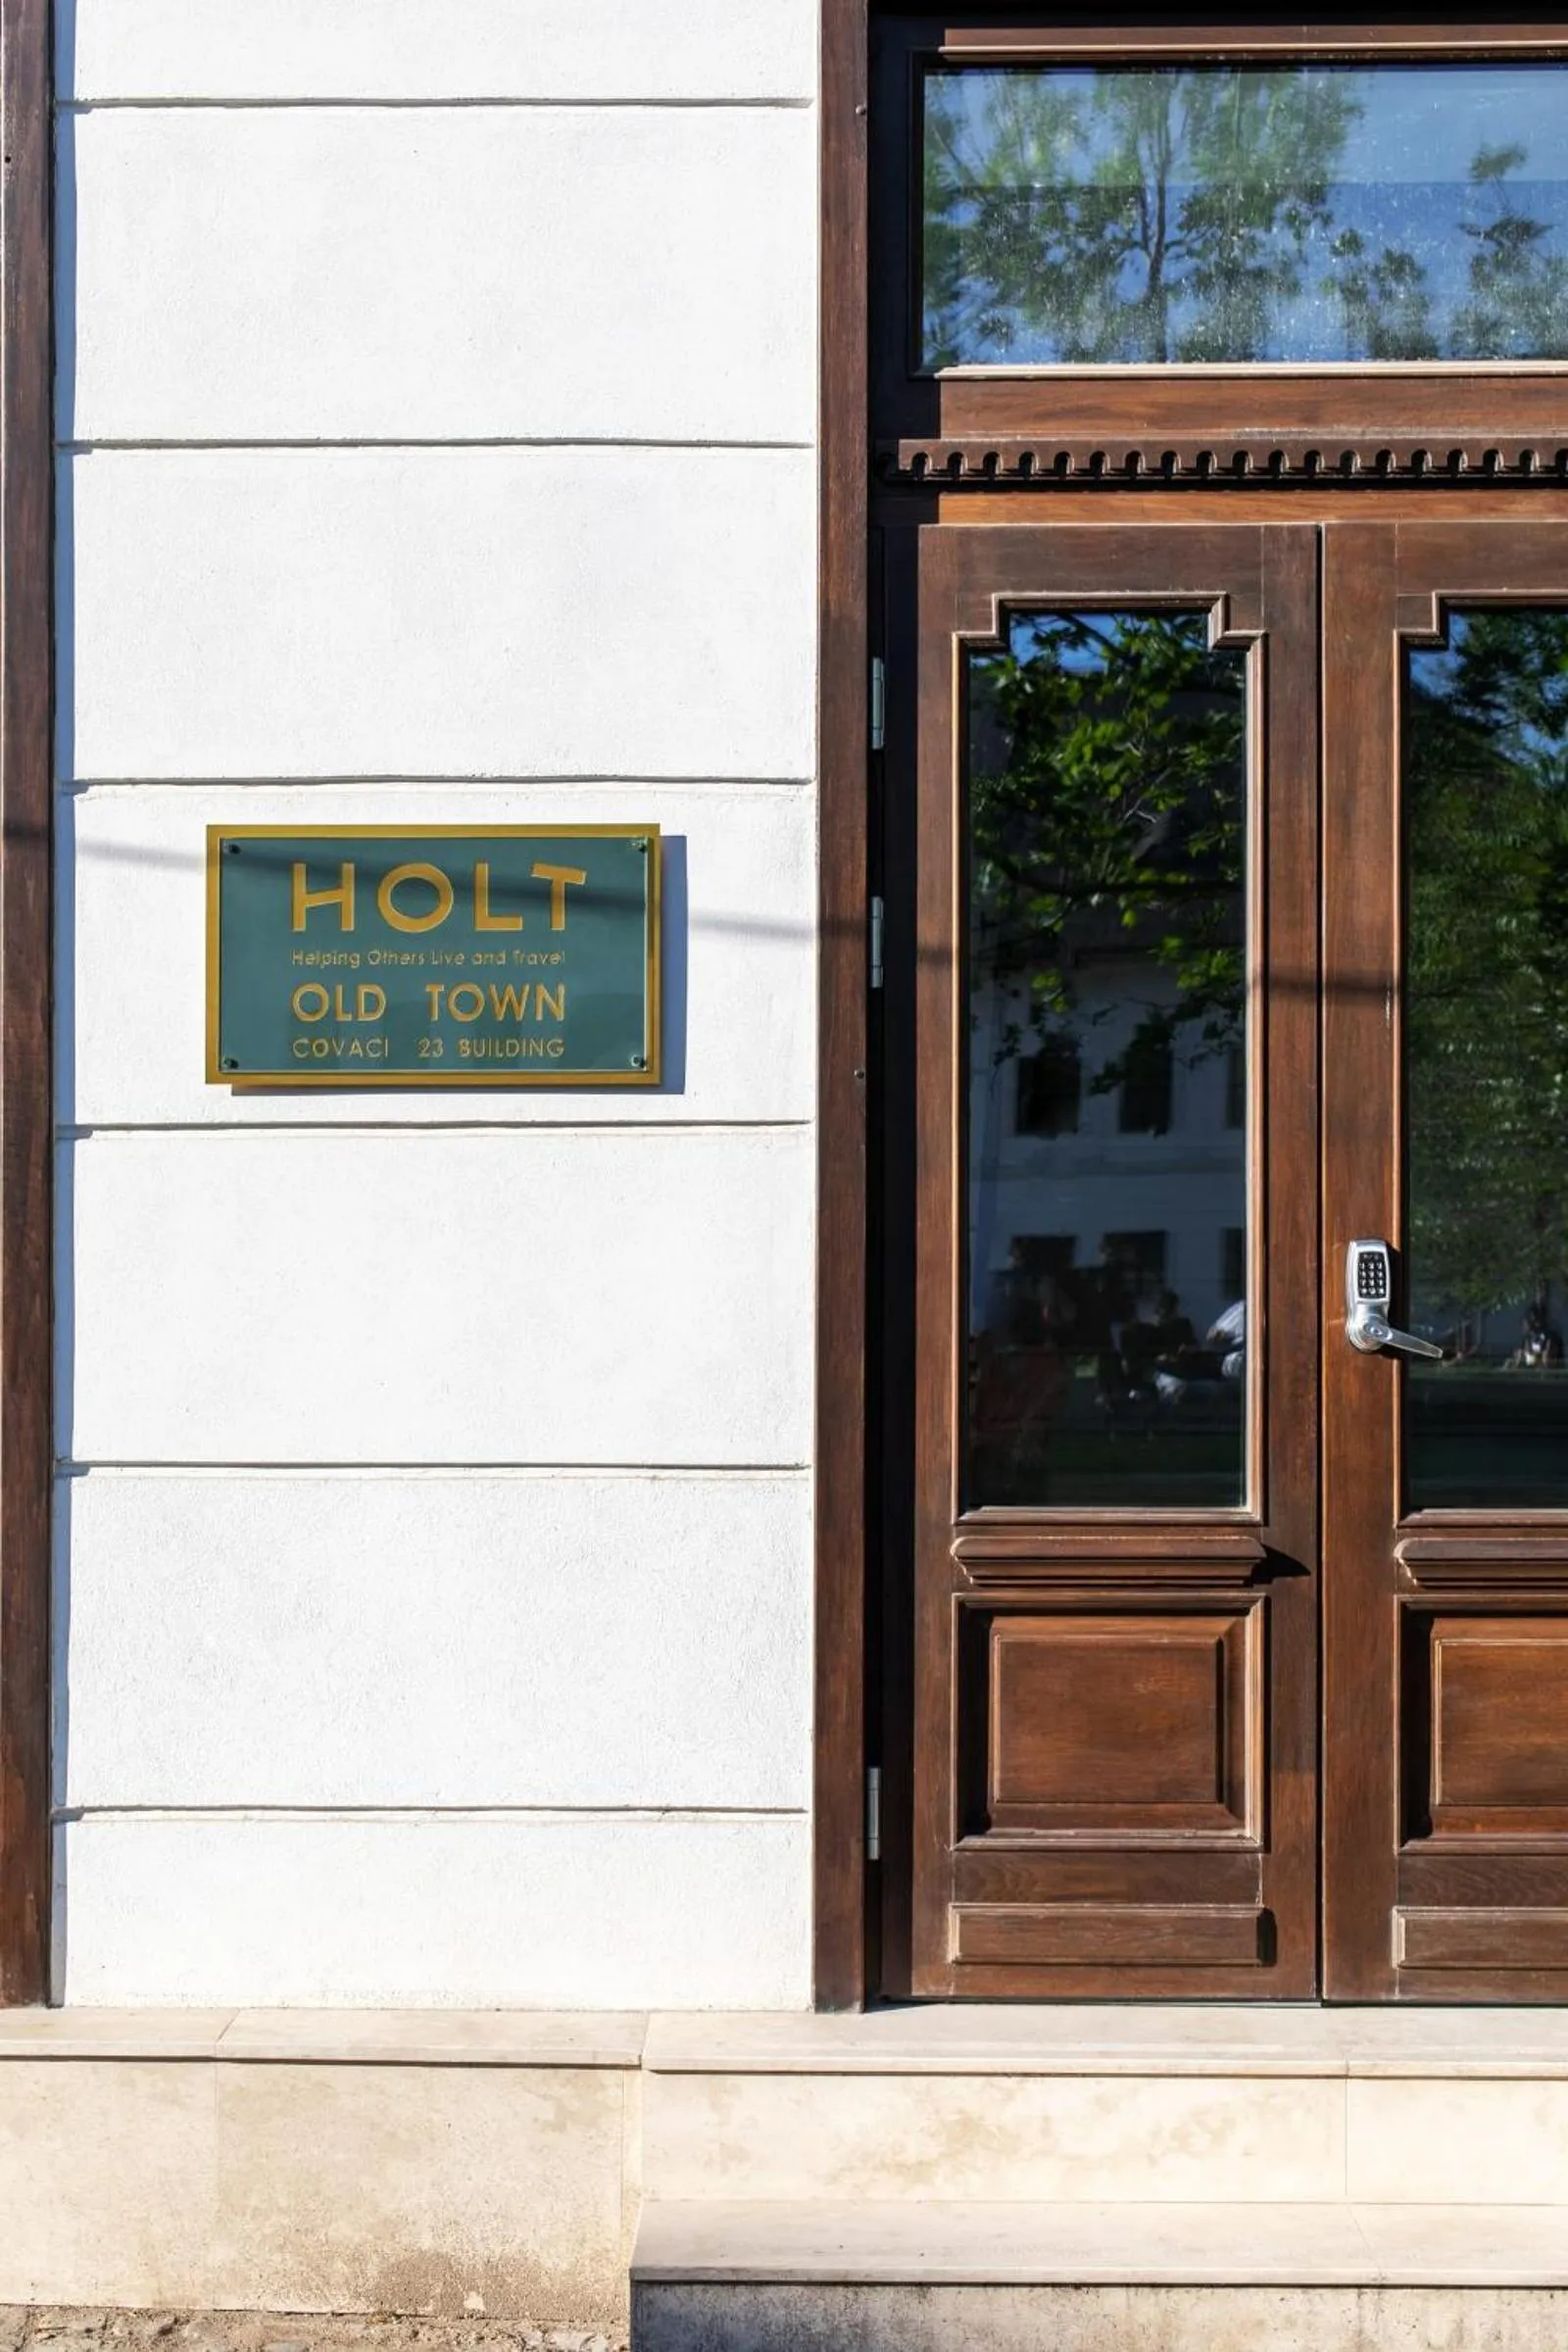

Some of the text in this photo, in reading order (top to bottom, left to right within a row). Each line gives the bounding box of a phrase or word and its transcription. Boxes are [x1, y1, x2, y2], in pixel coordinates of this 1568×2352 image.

[291, 861, 587, 933] HOLT
[291, 949, 565, 969] Helping Others Live and Travel
[291, 982, 565, 1022] OLD TOWN
[292, 1037, 565, 1059] COVACI 23 BUILDING
